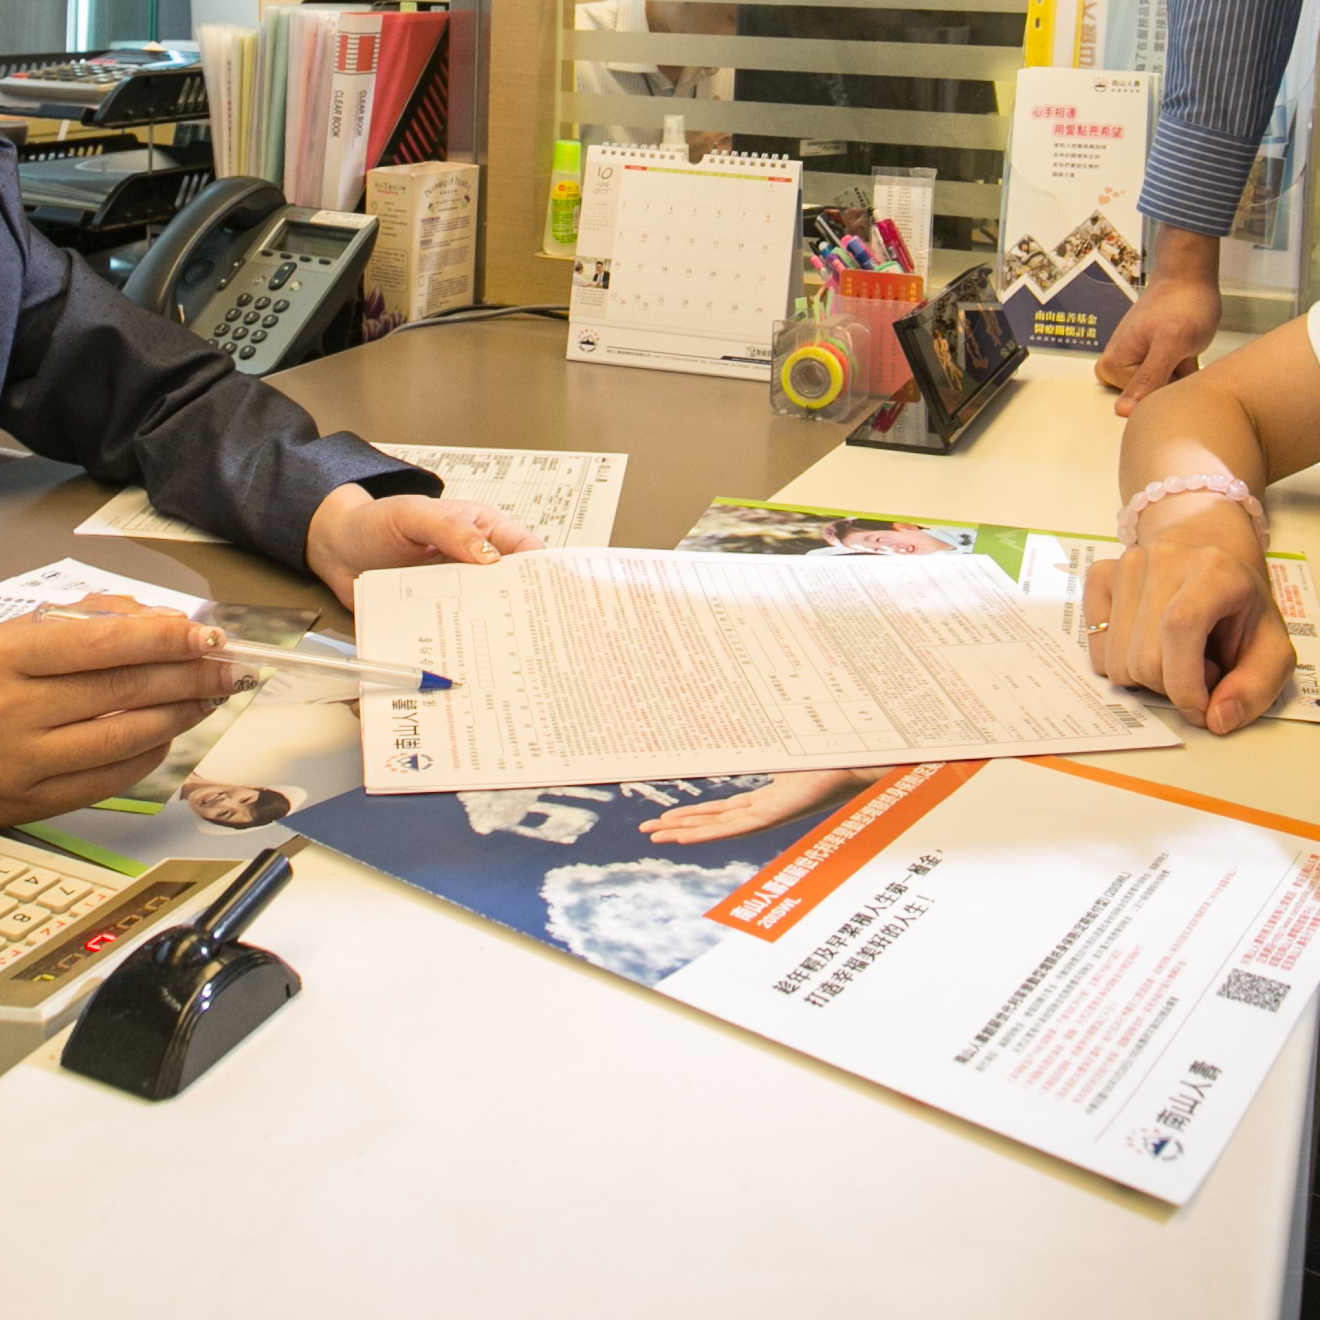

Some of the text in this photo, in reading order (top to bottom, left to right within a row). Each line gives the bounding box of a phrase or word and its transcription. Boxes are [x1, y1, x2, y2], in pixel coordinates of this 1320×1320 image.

[331, 90, 344, 138] CLEAR BOOK
[356, 90, 368, 137] CLEAR BOOK
[1032, 106, 1076, 119] 心手相連
[1053, 124, 1123, 138] 用愛點亮希望
[597, 166, 614, 180] 10
[391, 698, 422, 750] 南山人壽
[24, 875, 40, 886] 4
[58, 886, 76, 896] 7
[12, 913, 32, 923] 8
[1156, 1059, 1222, 1132] 南山人壽
